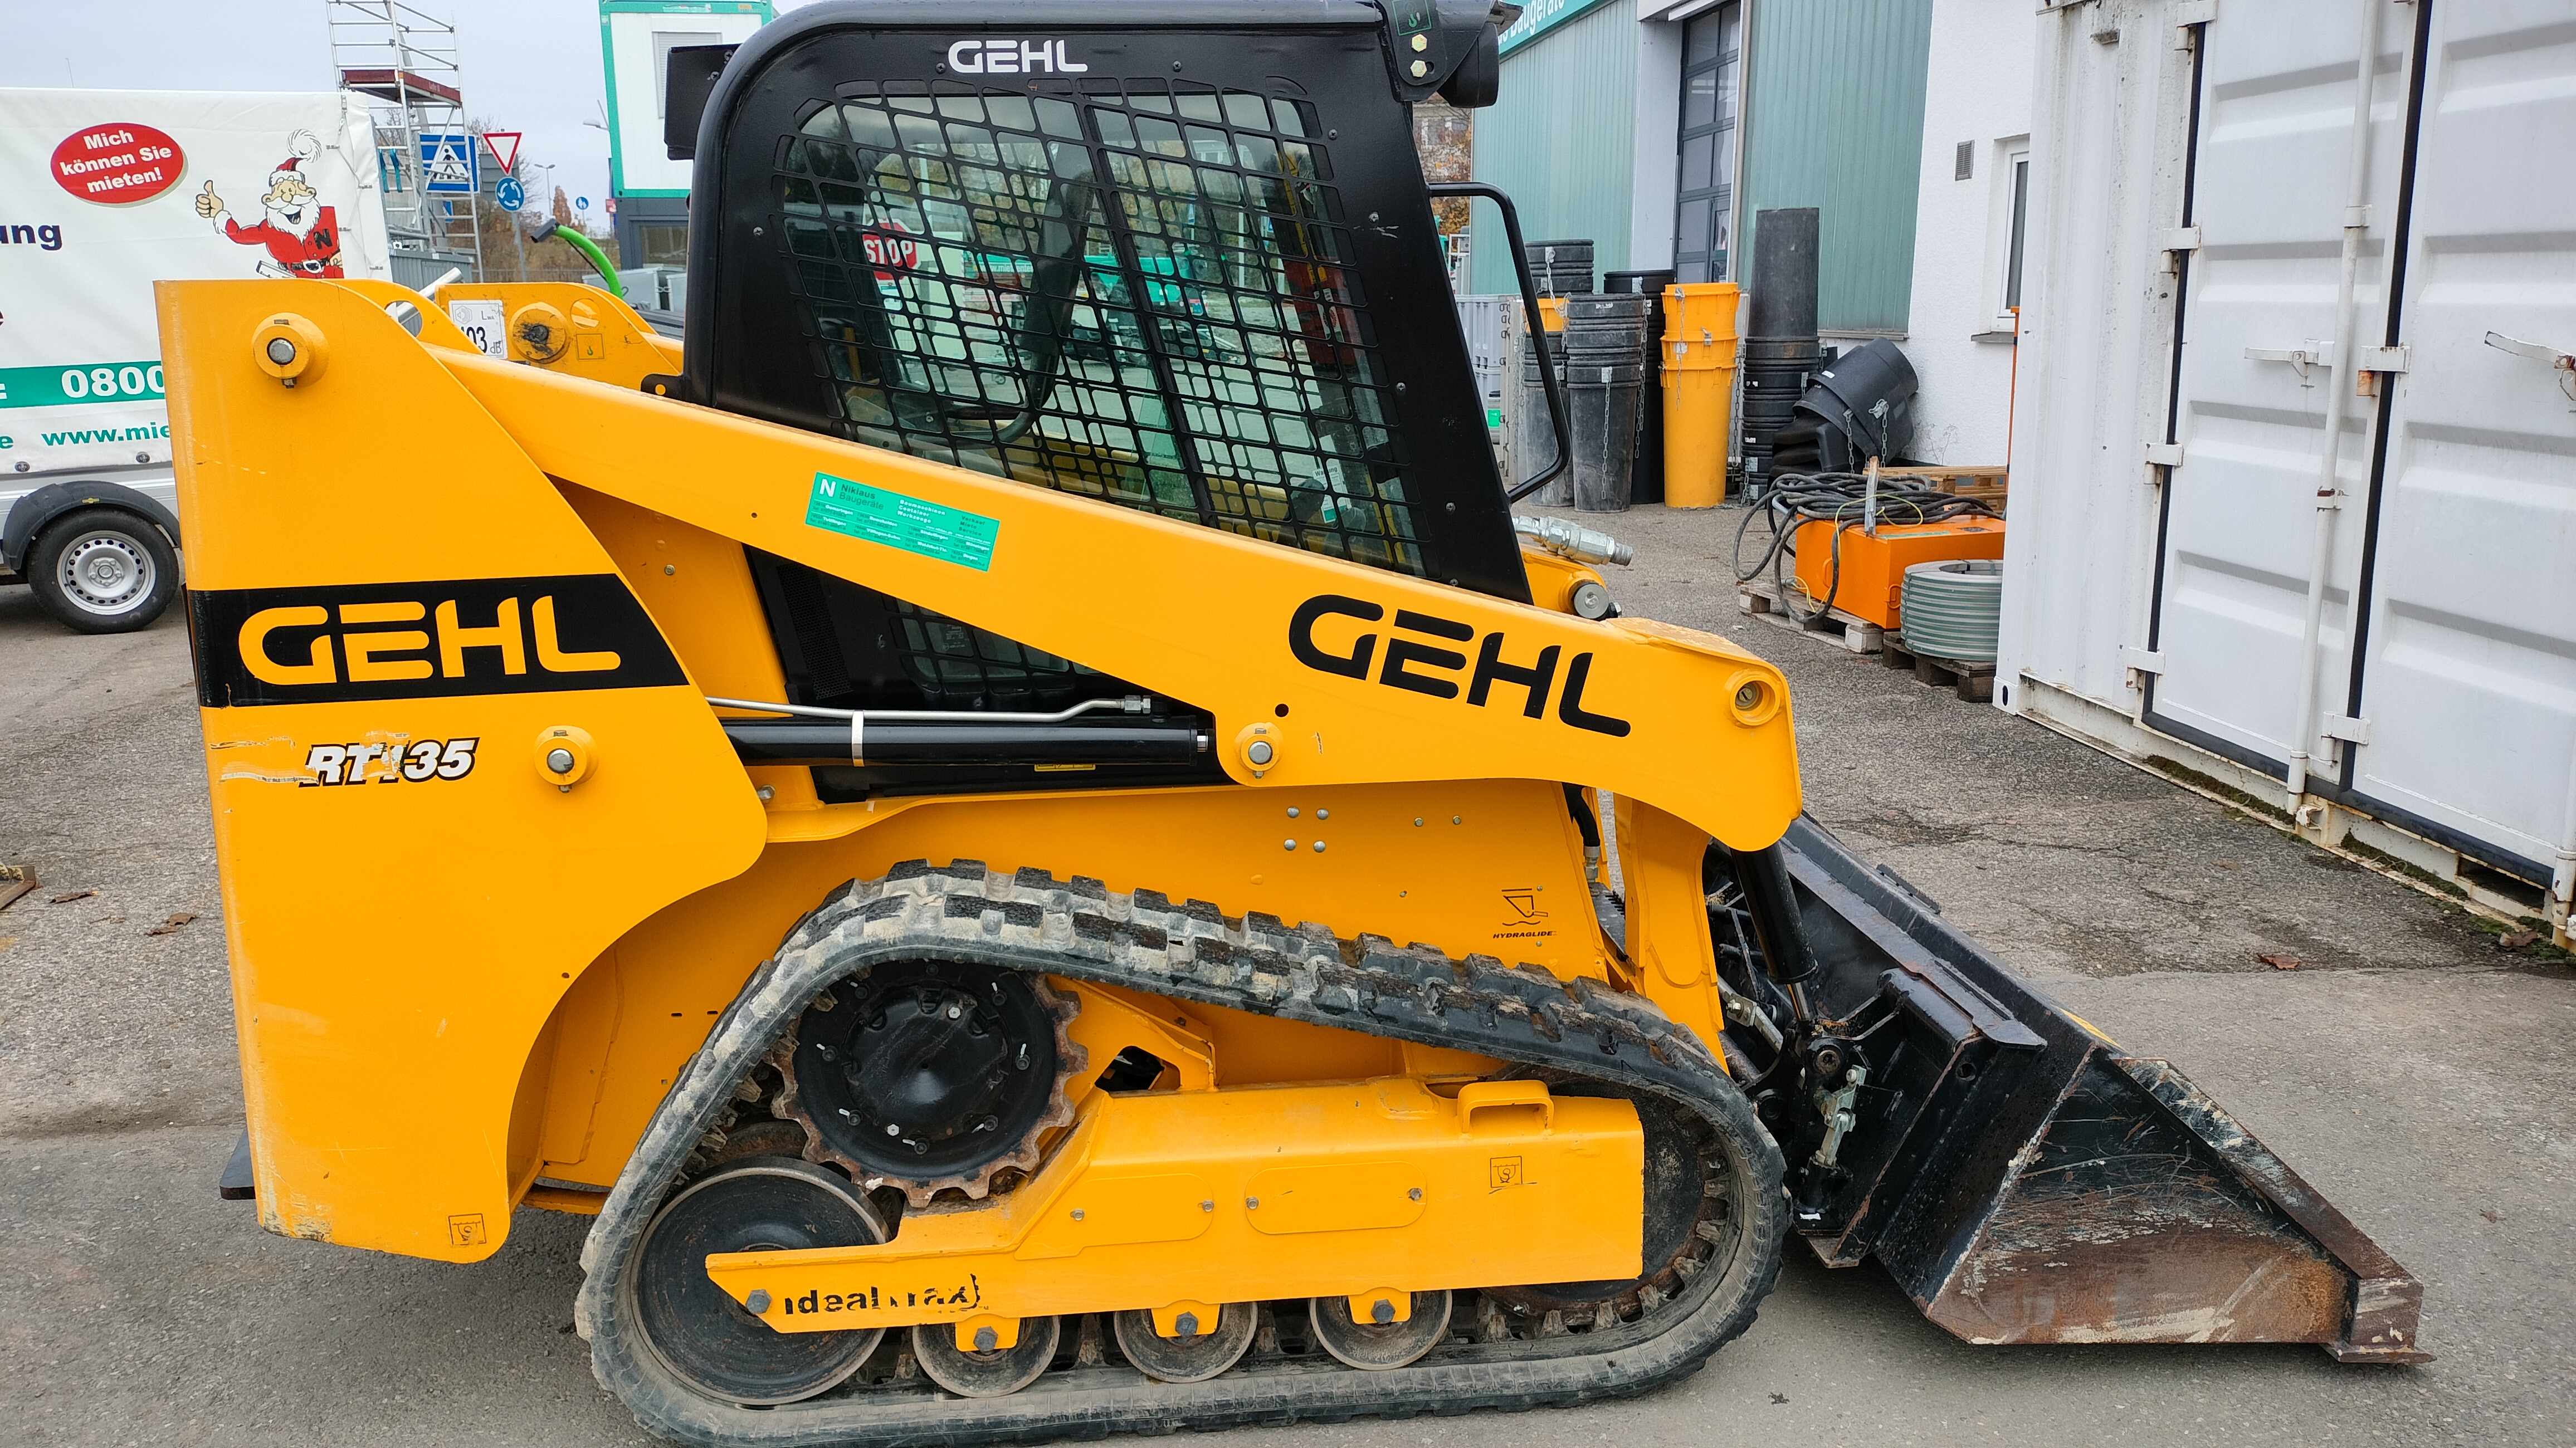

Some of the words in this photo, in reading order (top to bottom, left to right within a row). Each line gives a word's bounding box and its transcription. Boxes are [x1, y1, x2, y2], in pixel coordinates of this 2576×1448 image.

[948, 39, 1088, 74] GEHL
[83, 130, 134, 150] Mich
[60, 153, 136, 175] können
[139, 146, 172, 162] Sie
[87, 167, 163, 193] mieten!
[314, 229, 333, 250] N
[864, 239, 914, 265] STOP
[461, 326, 487, 354] 03
[61, 365, 165, 398] 0800
[819, 478, 836, 497] N
[841, 483, 876, 499] Niklaus
[839, 492, 884, 510] Baugeräte
[238, 595, 621, 686] GEHL
[1289, 594, 1631, 738] GEHL
